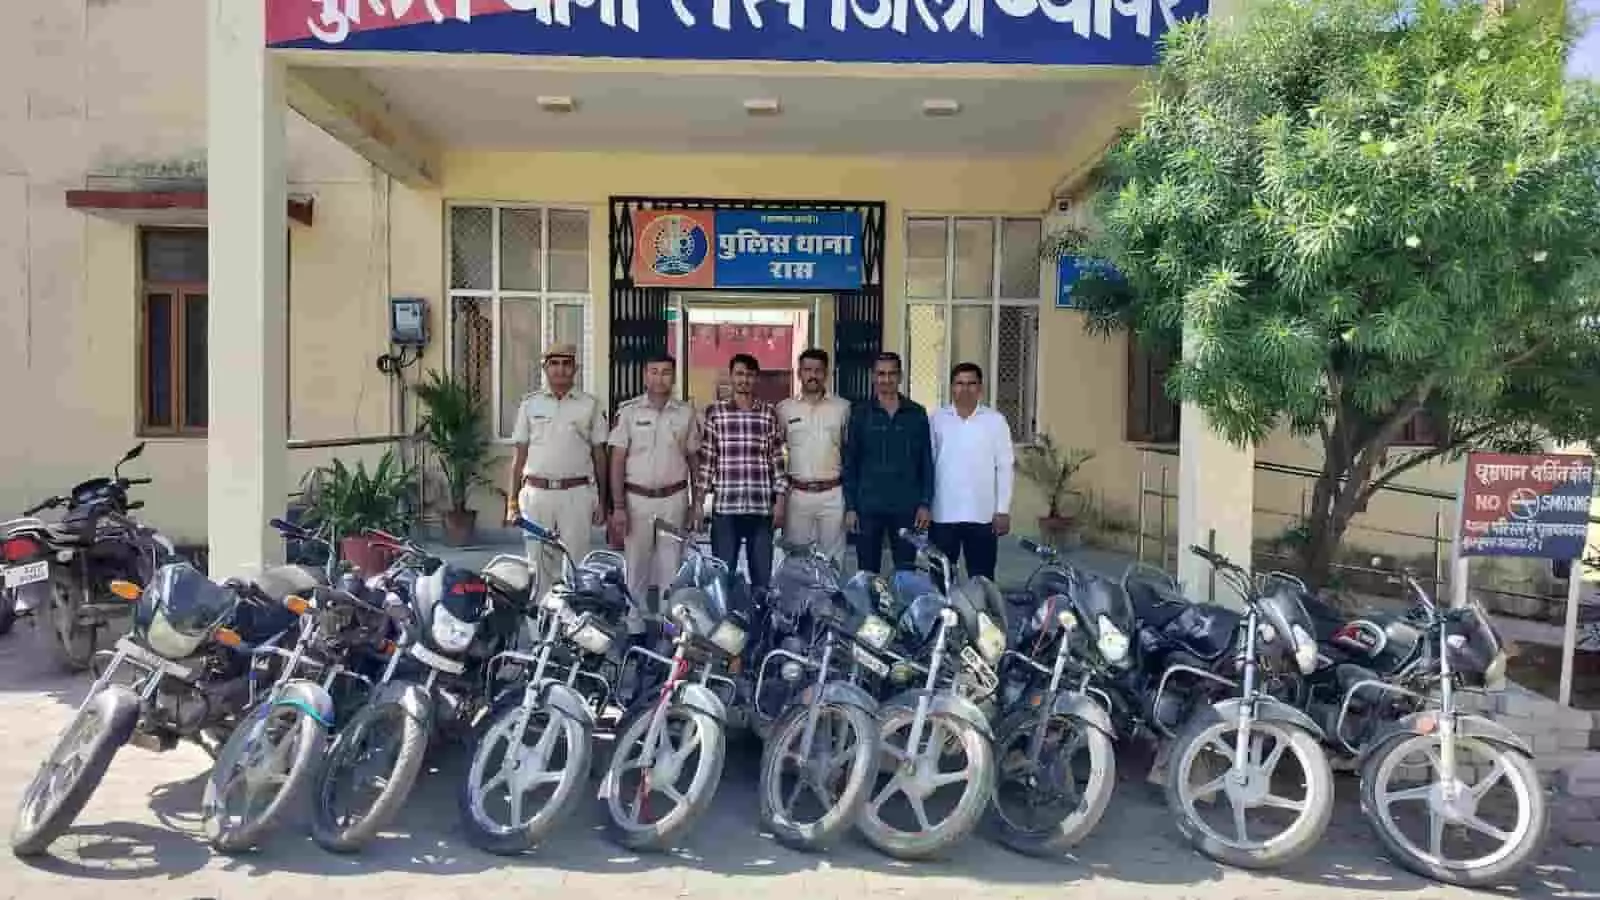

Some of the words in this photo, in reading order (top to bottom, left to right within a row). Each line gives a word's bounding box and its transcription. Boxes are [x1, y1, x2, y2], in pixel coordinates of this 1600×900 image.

[718, 228, 794, 260] पुलिस
[796, 234, 856, 255] थाना
[768, 260, 817, 280] रास
[1475, 494, 1501, 512] NO
